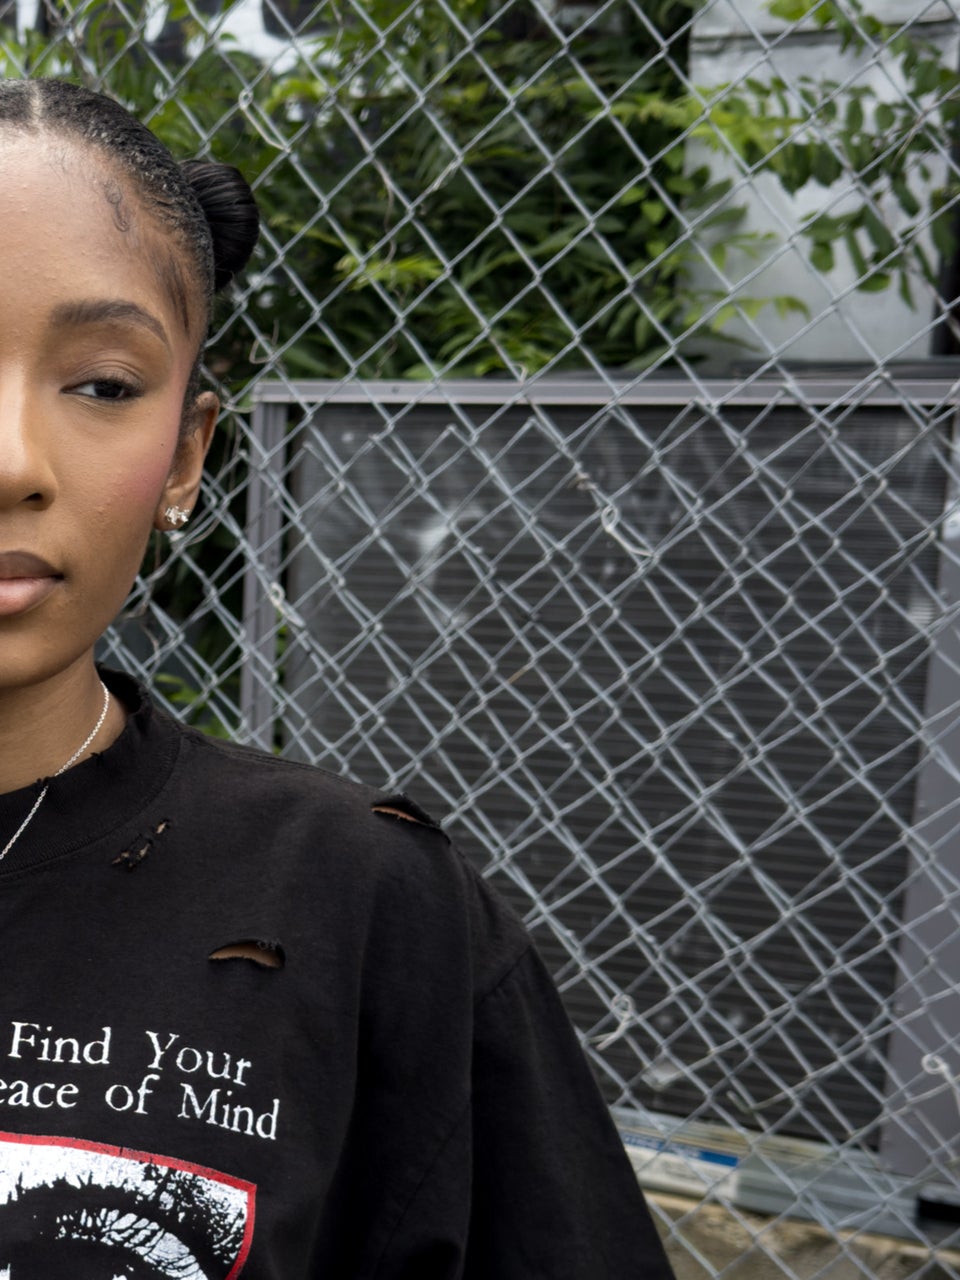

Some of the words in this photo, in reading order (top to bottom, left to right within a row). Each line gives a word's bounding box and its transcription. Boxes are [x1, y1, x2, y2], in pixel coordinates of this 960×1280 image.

[7, 1021, 112, 1065] Find
[145, 1031, 252, 1086] Your
[104, 1074, 160, 1115] of
[177, 1083, 281, 1141] Mind
